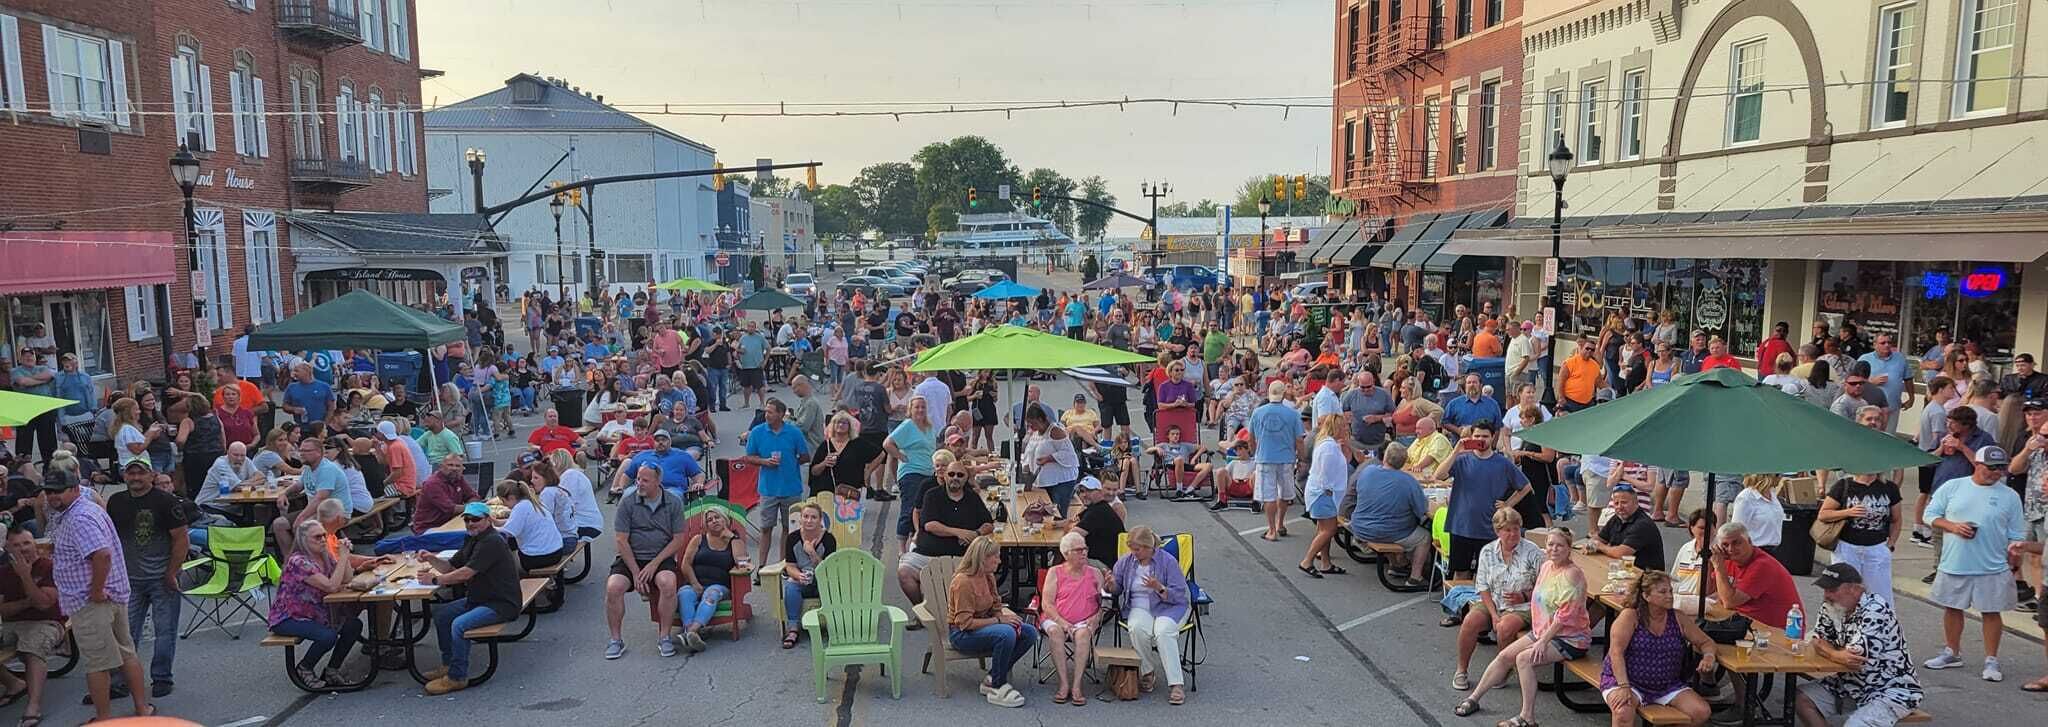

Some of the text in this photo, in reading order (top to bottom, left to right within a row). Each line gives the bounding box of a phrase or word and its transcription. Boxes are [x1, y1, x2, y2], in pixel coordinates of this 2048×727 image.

[225, 167, 255, 190] House
[352, 269, 384, 280] Island
[385, 269, 412, 280] House
[1967, 273, 2001, 291] OPEN
